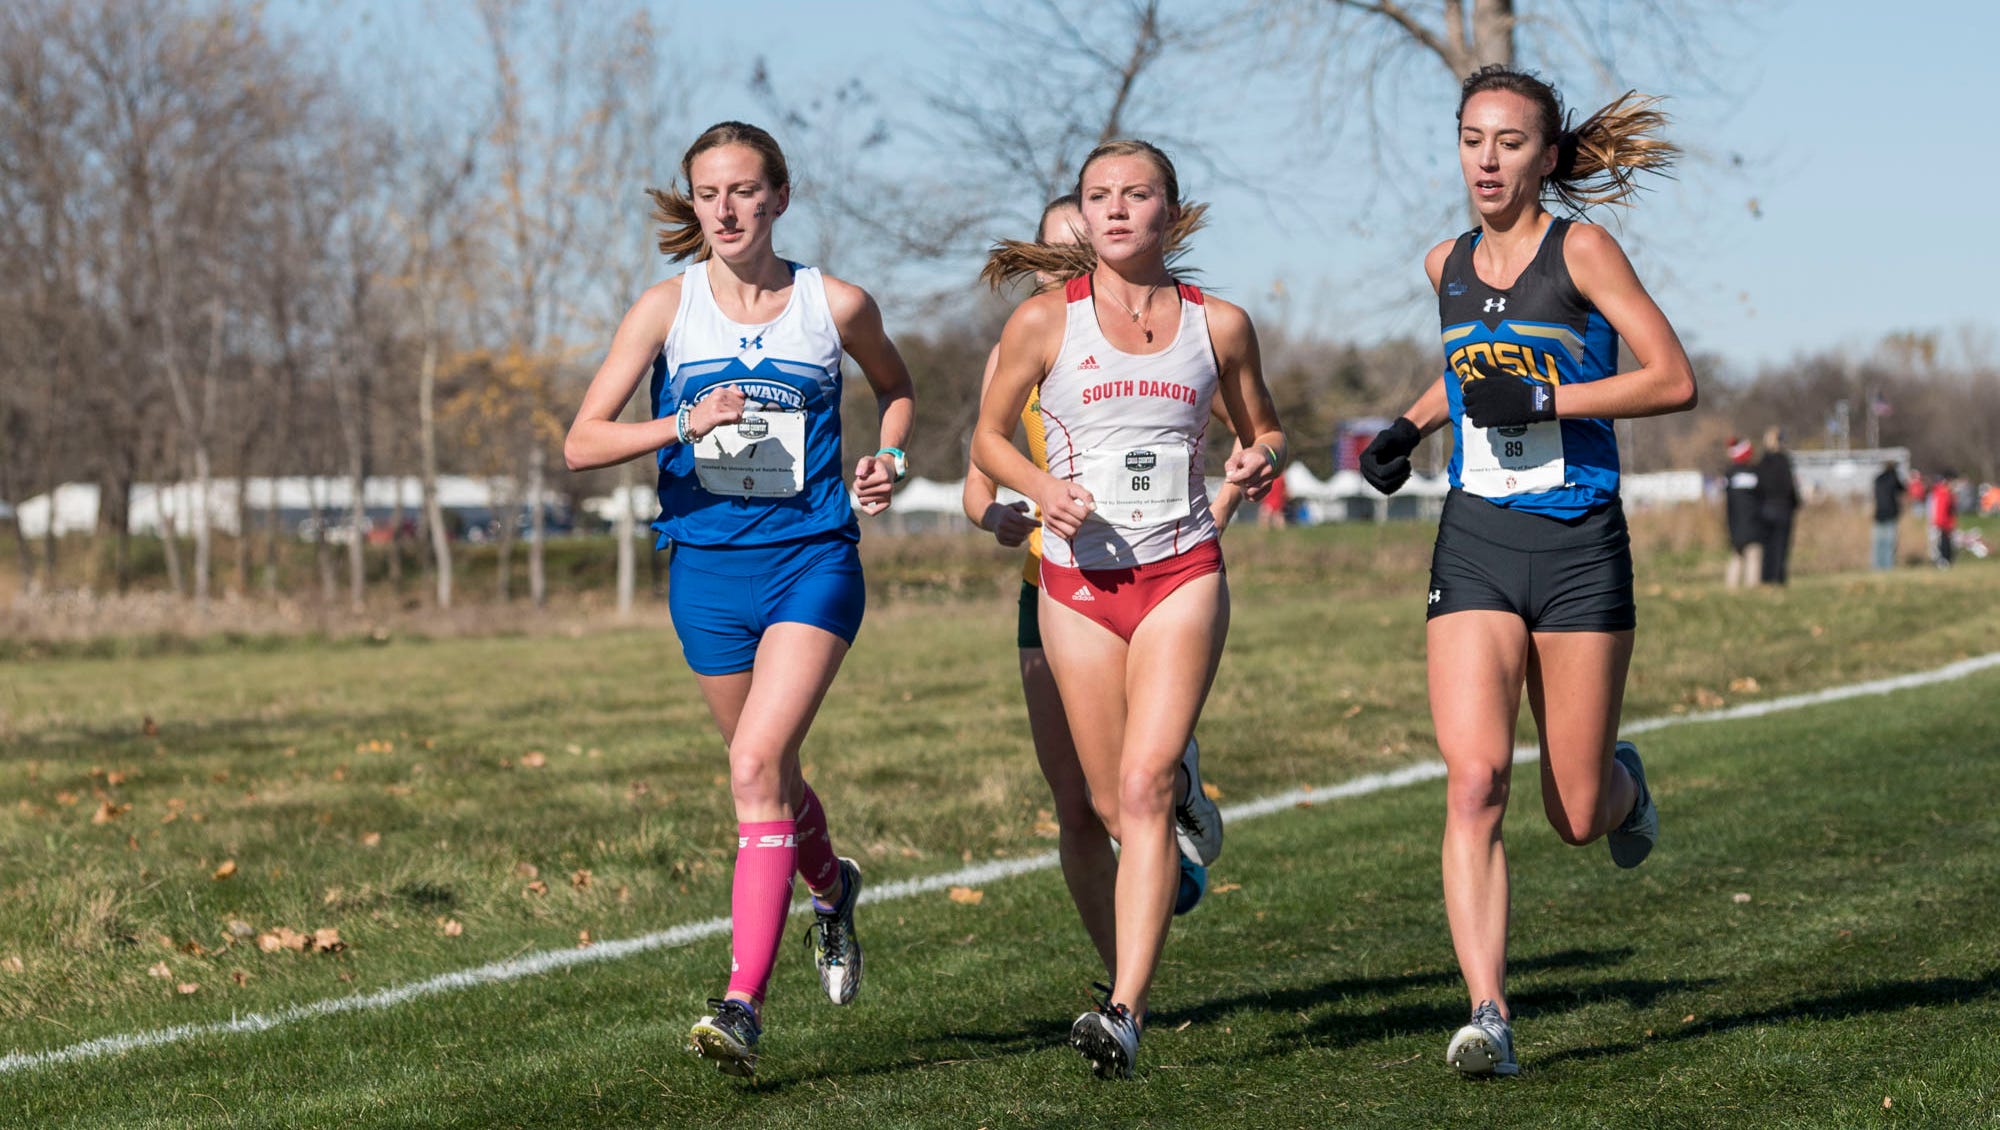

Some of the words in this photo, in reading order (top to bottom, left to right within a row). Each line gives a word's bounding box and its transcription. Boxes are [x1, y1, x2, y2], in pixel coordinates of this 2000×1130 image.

[746, 385, 801, 408] WAYNE
[1082, 380, 1134, 404] SOUTH
[1138, 380, 1197, 406] DAKOTA
[748, 443, 757, 458] 7
[1504, 441, 1523, 457] 89
[1131, 475, 1150, 491] 66
